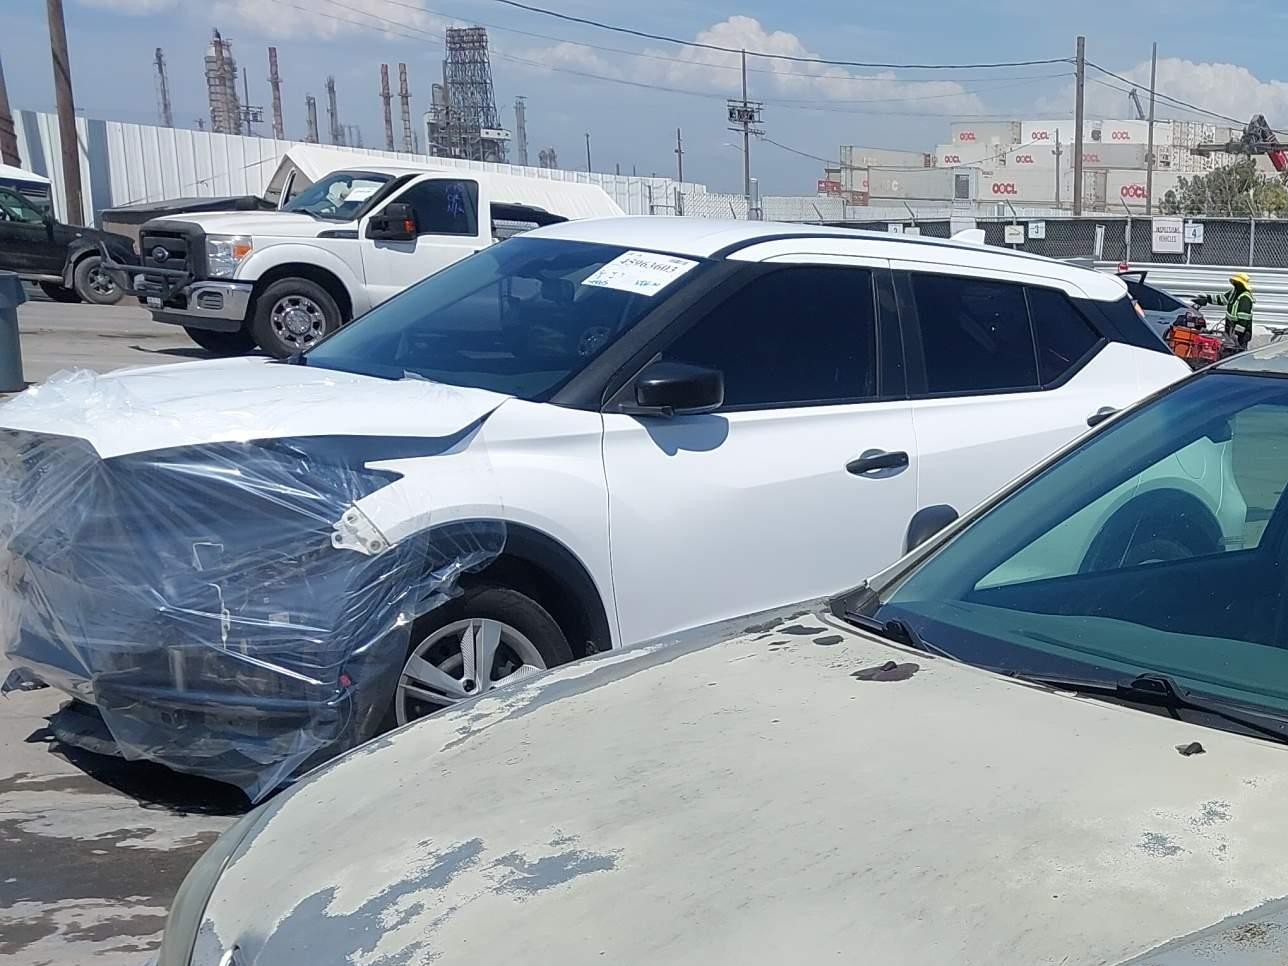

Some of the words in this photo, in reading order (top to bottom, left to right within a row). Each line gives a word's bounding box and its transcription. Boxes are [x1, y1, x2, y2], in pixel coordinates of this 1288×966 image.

[1031, 131, 1049, 140] OOCL
[1111, 131, 1131, 140] OOCL
[1015, 155, 1034, 164] OOCL
[992, 183, 1017, 194] OOCL
[1120, 185, 1148, 199] OOCL
[1191, 228, 1197, 239] 4
